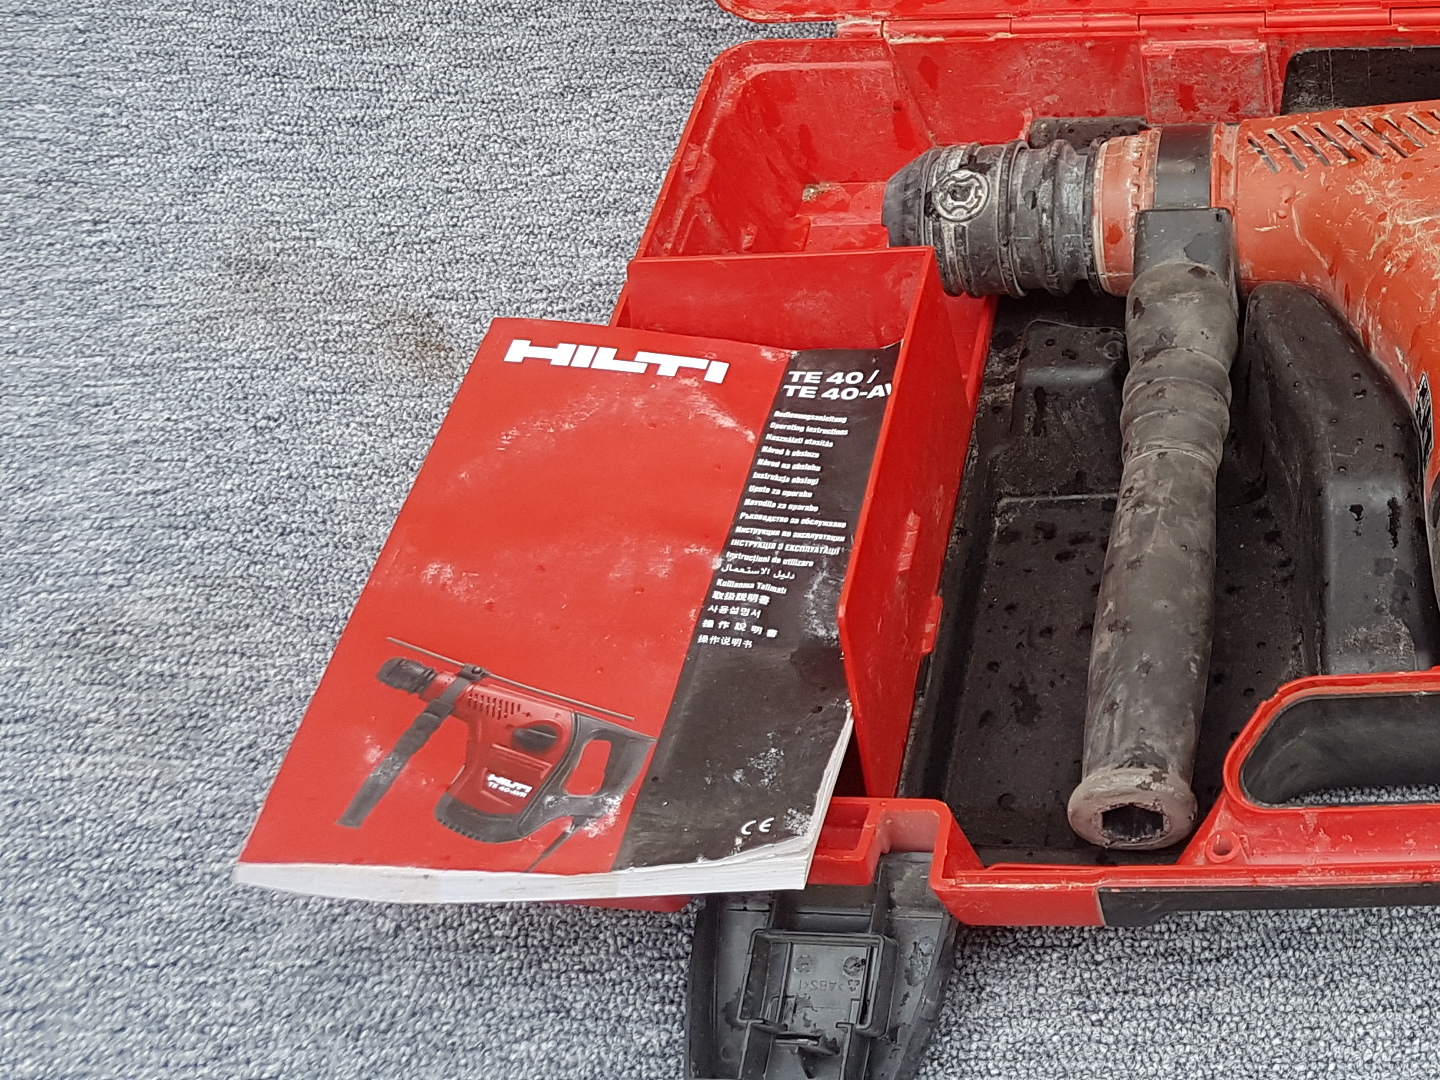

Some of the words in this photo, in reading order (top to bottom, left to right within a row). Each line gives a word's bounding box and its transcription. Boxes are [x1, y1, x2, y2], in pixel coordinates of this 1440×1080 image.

[504, 339, 729, 384] HILTI
[788, 371, 823, 384] TE
[826, 371, 864, 385] 40
[783, 385, 818, 399] TE
[770, 422, 805, 433] Operating
